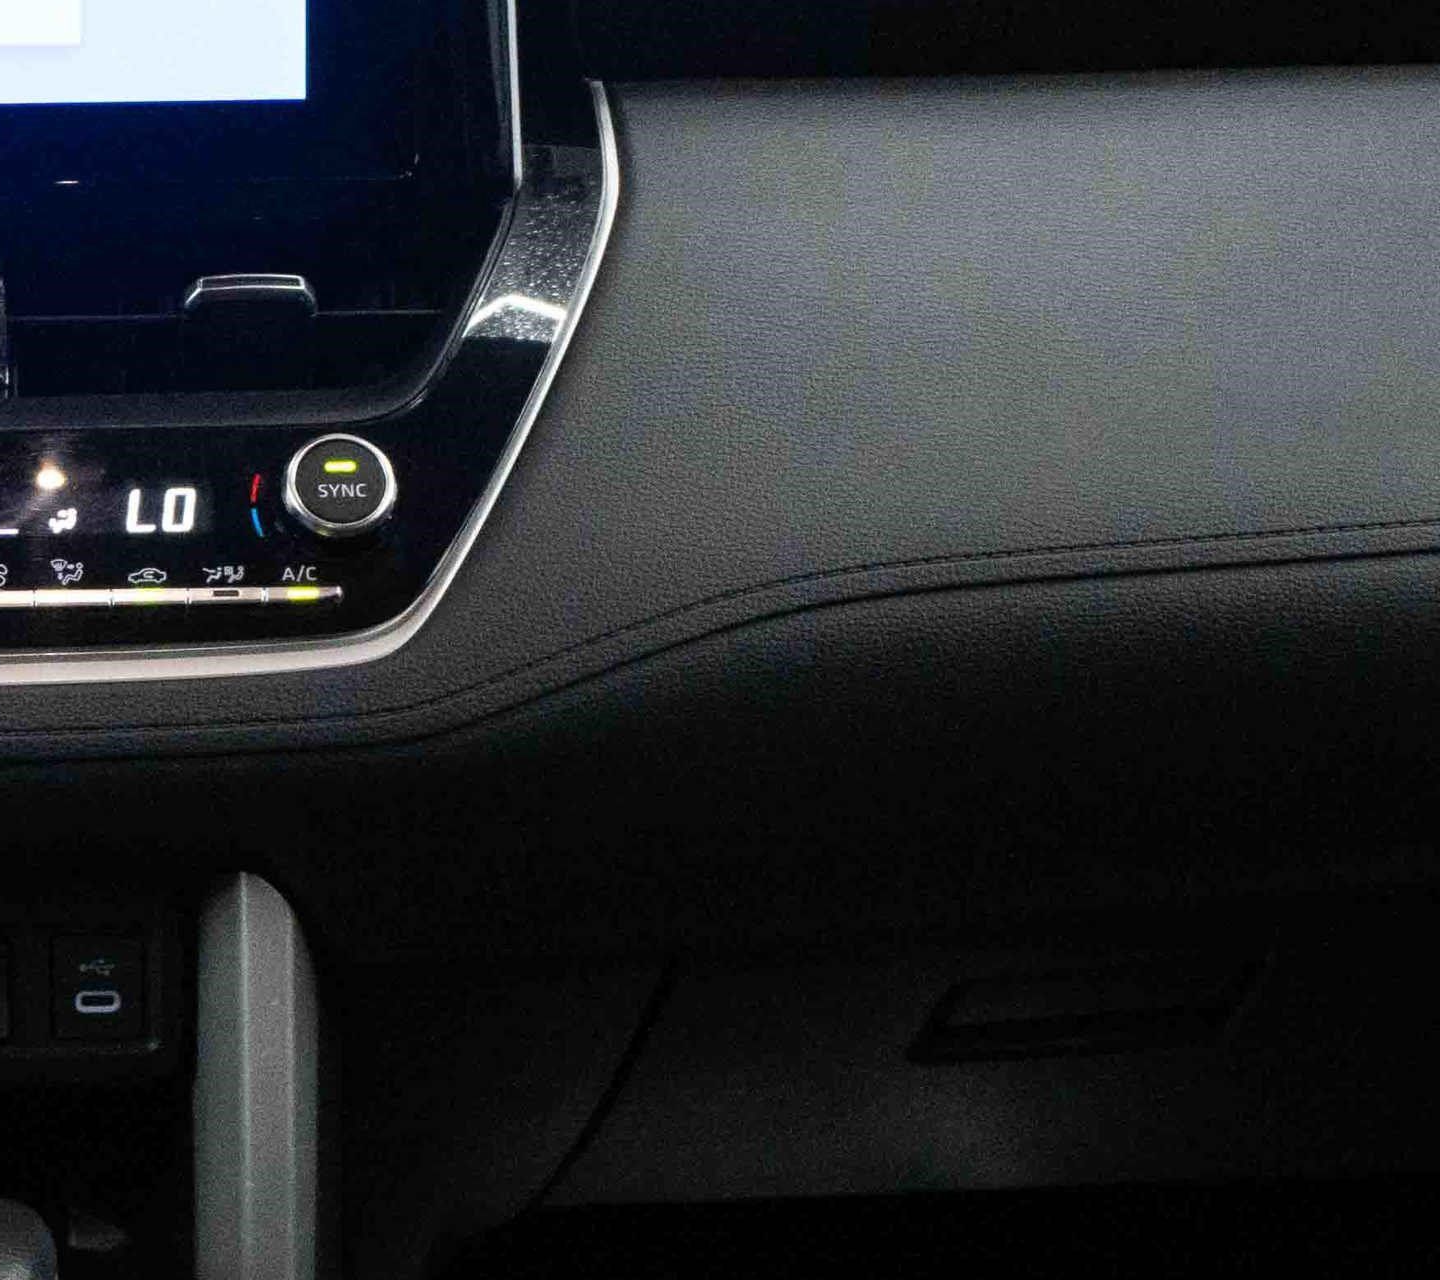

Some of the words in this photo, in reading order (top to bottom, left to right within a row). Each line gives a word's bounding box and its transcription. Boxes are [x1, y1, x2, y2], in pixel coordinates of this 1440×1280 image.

[317, 482, 368, 499] SYNC
[126, 487, 197, 534] LO
[281, 565, 319, 583] A/C
